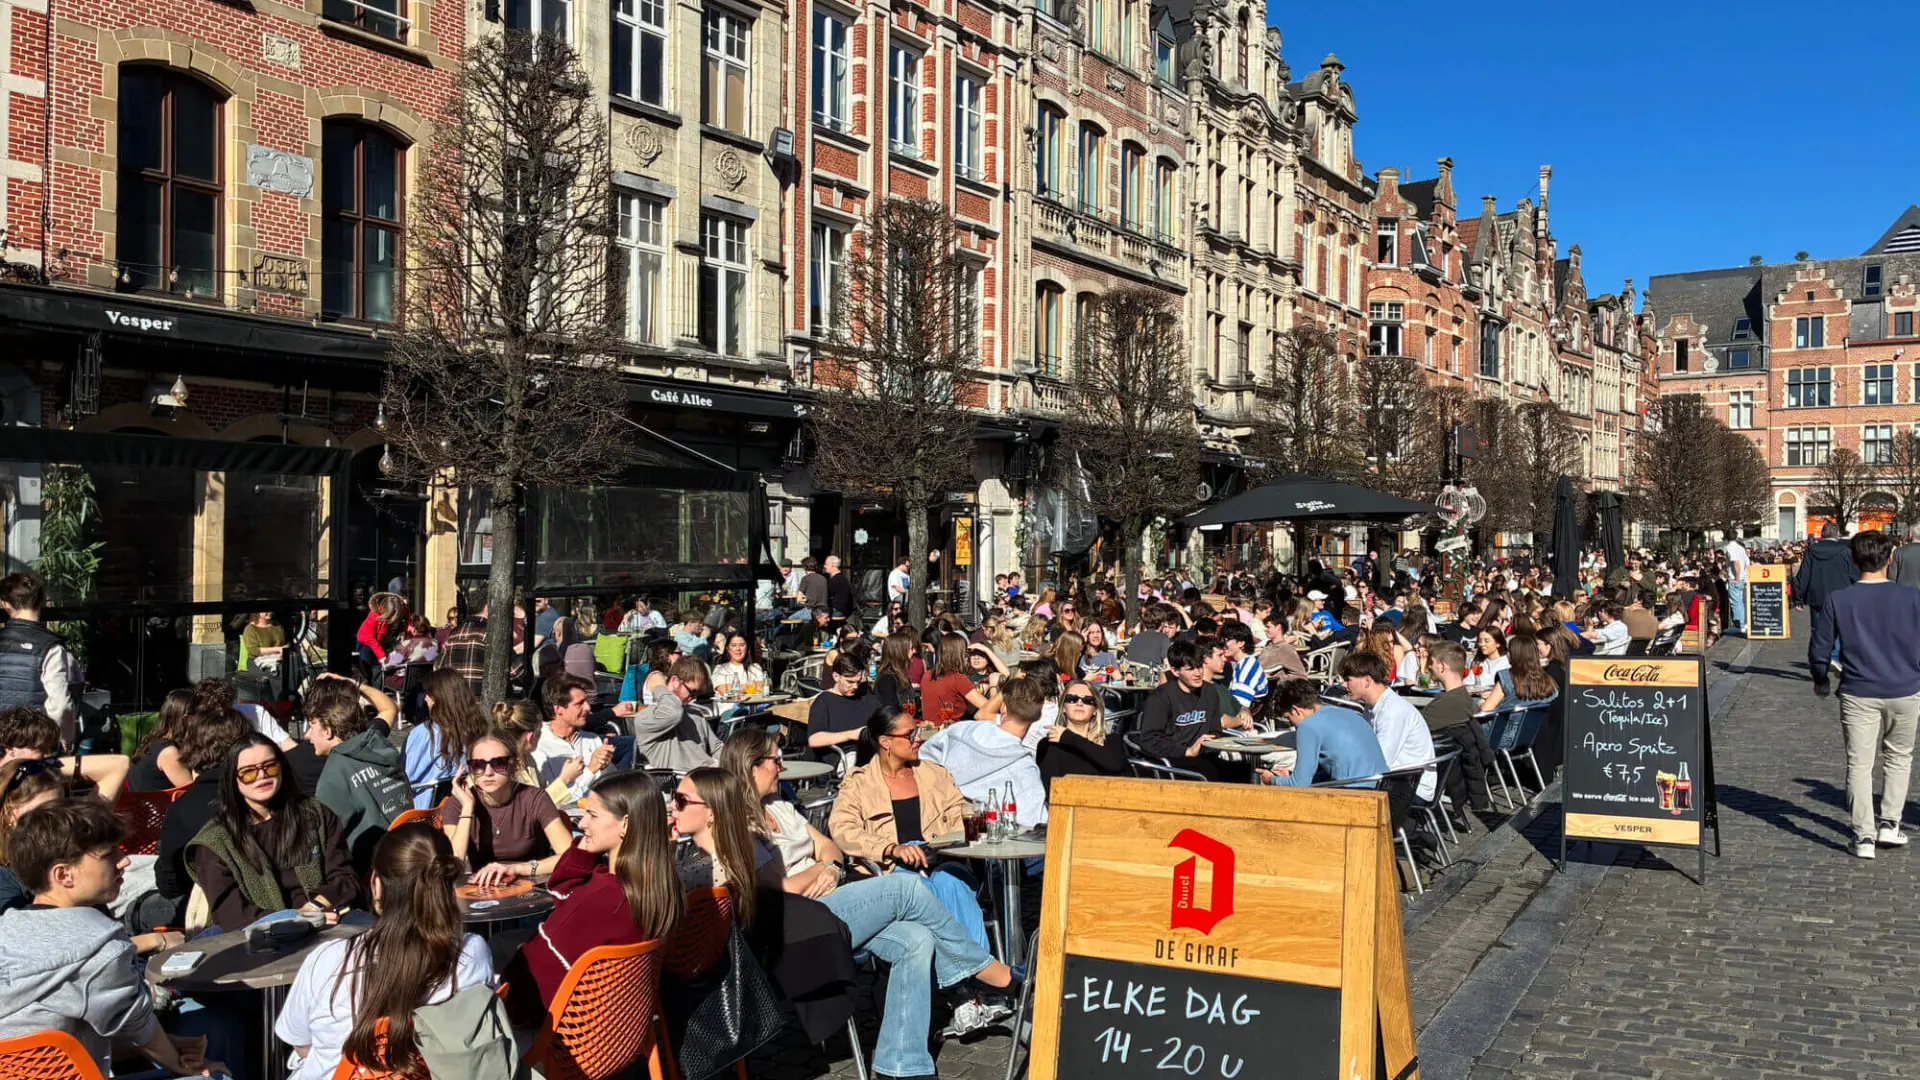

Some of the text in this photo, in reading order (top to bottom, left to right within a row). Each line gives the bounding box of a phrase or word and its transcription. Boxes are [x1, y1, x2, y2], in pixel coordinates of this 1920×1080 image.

[105, 311, 172, 330] Vesper
[651, 389, 713, 406] Café Allee
[1582, 688, 1687, 710] Salitos 2+1
[1583, 732, 1677, 760] Apero Spritz
[1614, 824, 1652, 833] VESPER
[1177, 875, 1190, 909] Duvel
[1155, 938, 1240, 968] DE GIRAF
[1185, 986, 1261, 1025] DAG
